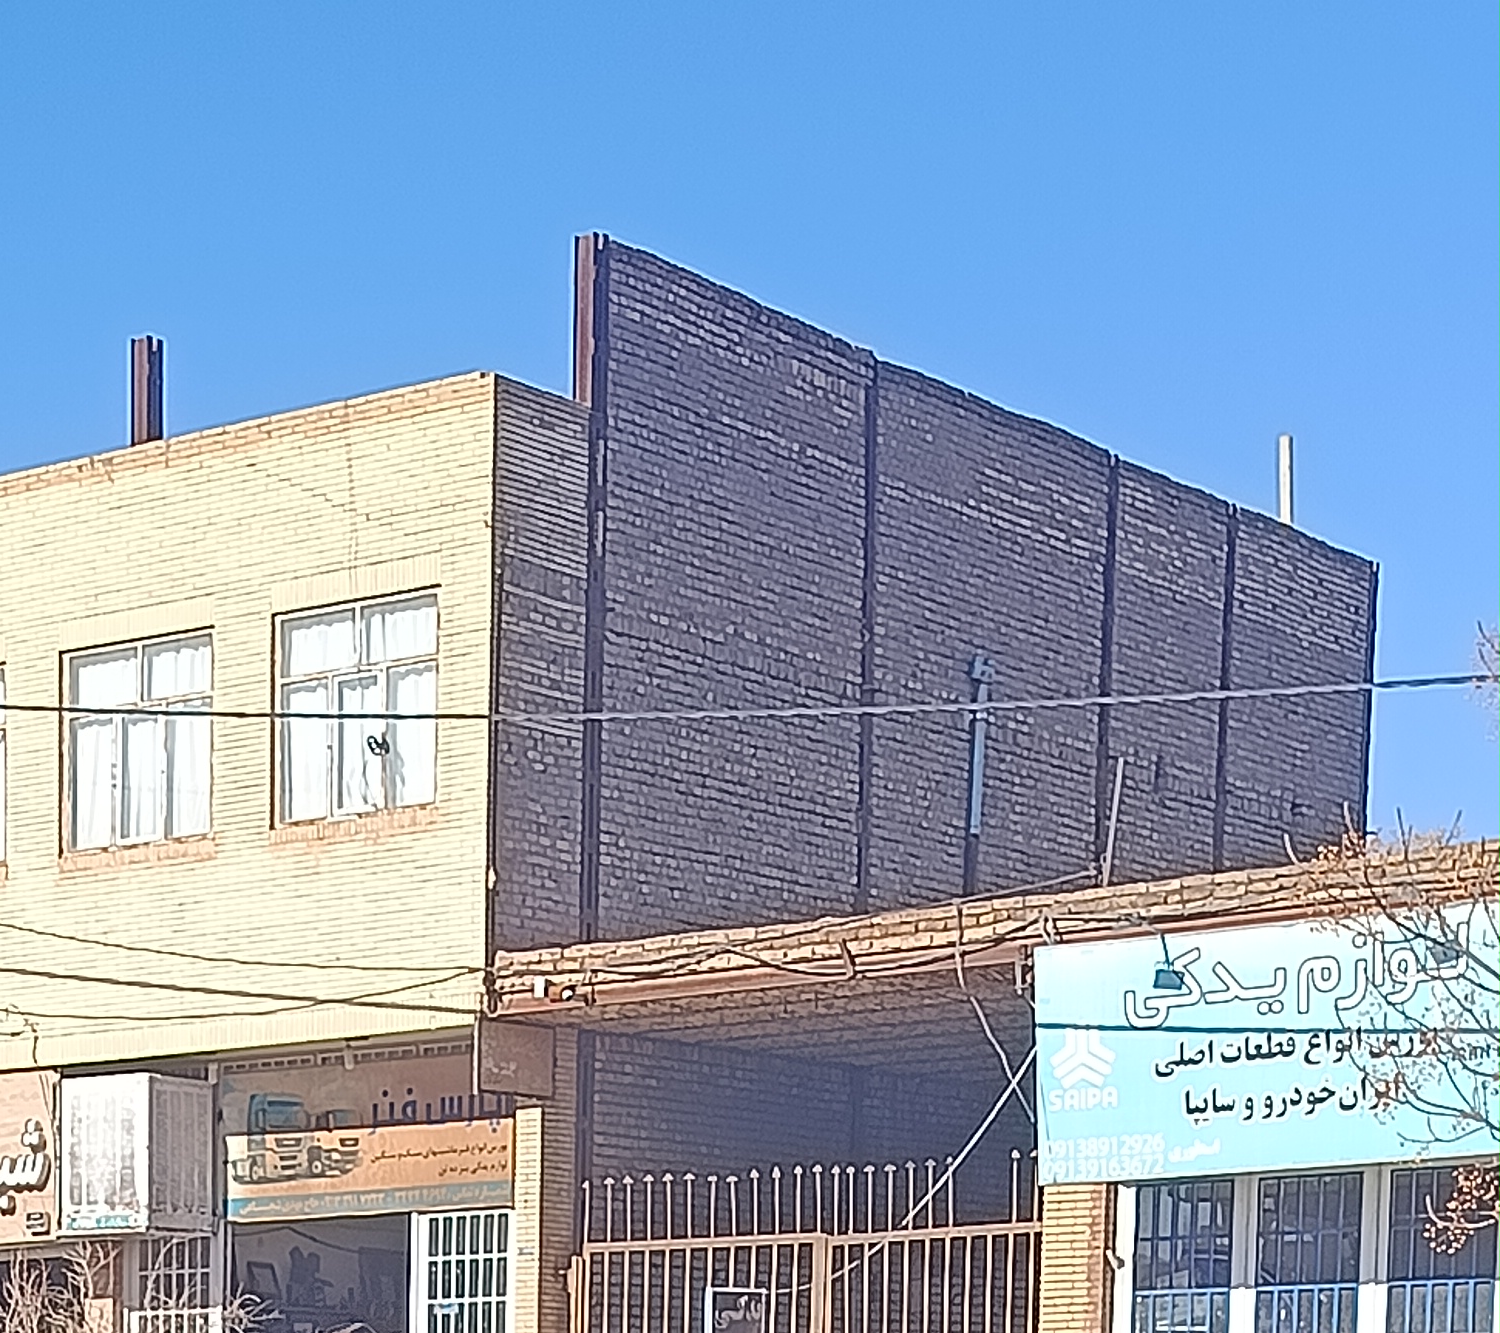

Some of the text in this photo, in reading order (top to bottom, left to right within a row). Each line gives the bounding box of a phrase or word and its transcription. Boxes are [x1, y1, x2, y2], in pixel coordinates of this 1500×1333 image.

[1124, 922, 1470, 1029] لوازم یدکی
[1155, 1039, 1214, 1077] اصلی
[1220, 1030, 1296, 1064] قطعات
[1303, 1027, 1362, 1065] انواع
[1048, 1086, 1119, 1113] SAIPA
[1185, 1088, 1236, 1125] سایپا
[1242, 1096, 1255, 1121] و
[1262, 1078, 1337, 1119] خودرو
